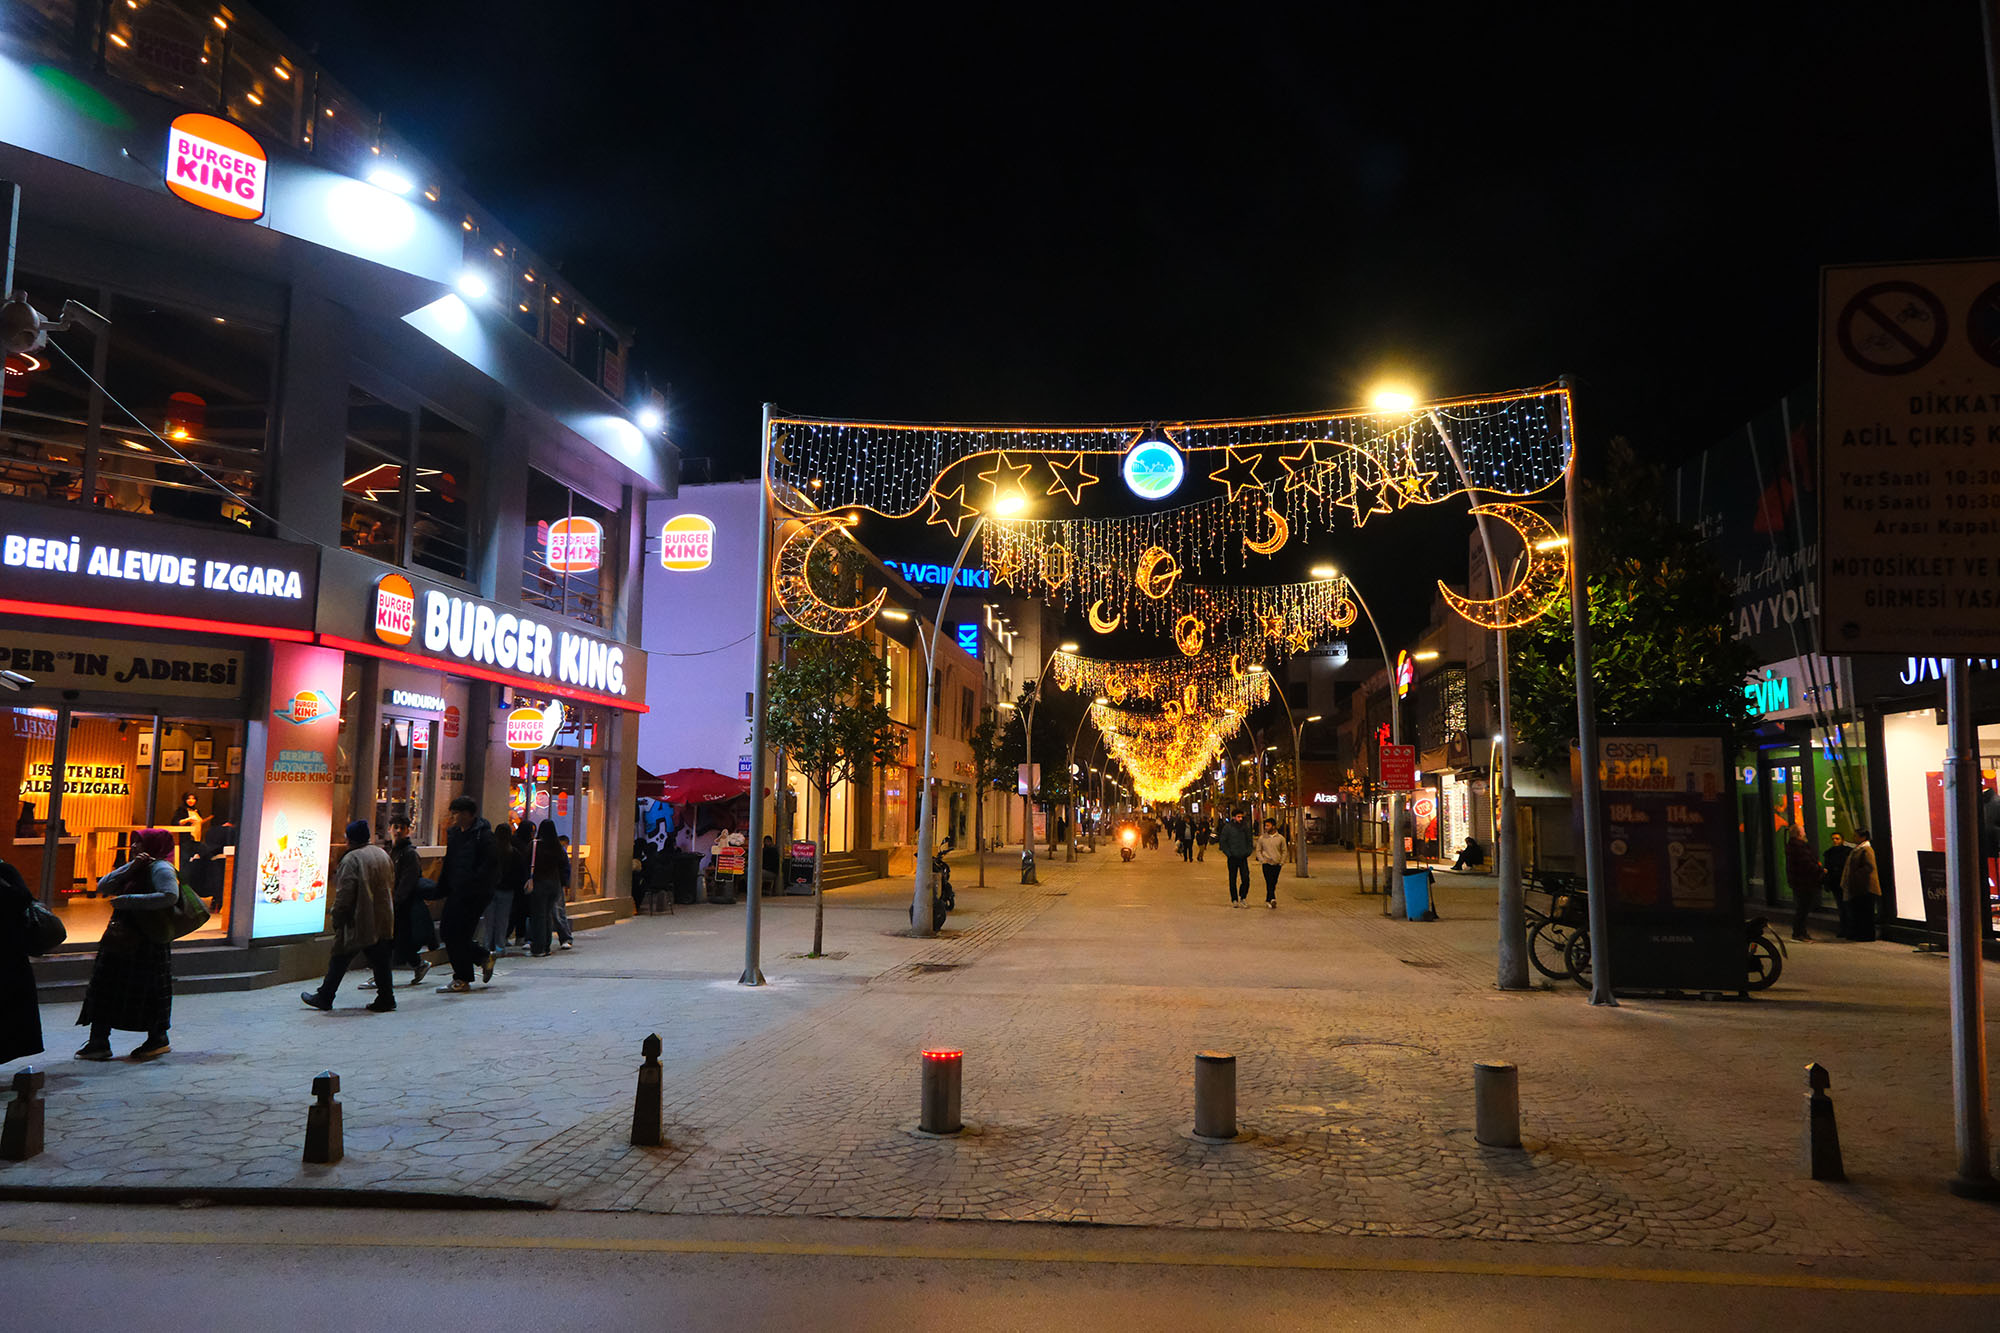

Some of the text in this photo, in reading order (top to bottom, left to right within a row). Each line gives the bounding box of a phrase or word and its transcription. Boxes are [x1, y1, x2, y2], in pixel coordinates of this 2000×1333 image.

[178, 138, 258, 180] BURGER
[176, 155, 256, 201] KING
[1909, 392, 2000, 415] DİKKAT
[1842, 424, 1897, 447] ACİL
[1908, 425, 1976, 448] ÇIKIŞ
[664, 533, 709, 544] BURGER
[664, 544, 709, 559] KING
[3, 534, 303, 599] BERİ ALEVDE IZGARA
[1832, 552, 1955, 578] MOTOSİKLET
[1963, 556, 1988, 577] VE
[378, 594, 413, 615] BURGER
[1865, 586, 1947, 610] GİRMESİ
[377, 609, 412, 633] KING
[424, 589, 553, 678] BURGER
[115, 656, 237, 686] ADRESİ
[294, 700, 319, 710] BURGER
[392, 690, 446, 712] DONDURMA
[294, 706, 318, 720] KING
[507, 730, 544, 742] KING
[508, 721, 544, 731] BURGER
[1606, 742, 1659, 760] essen
[95, 763, 125, 780] BERİ
[266, 770, 306, 783] BURGER
[308, 771, 334, 784] KING
[19, 779, 130, 796] ALEDE IZGARA
